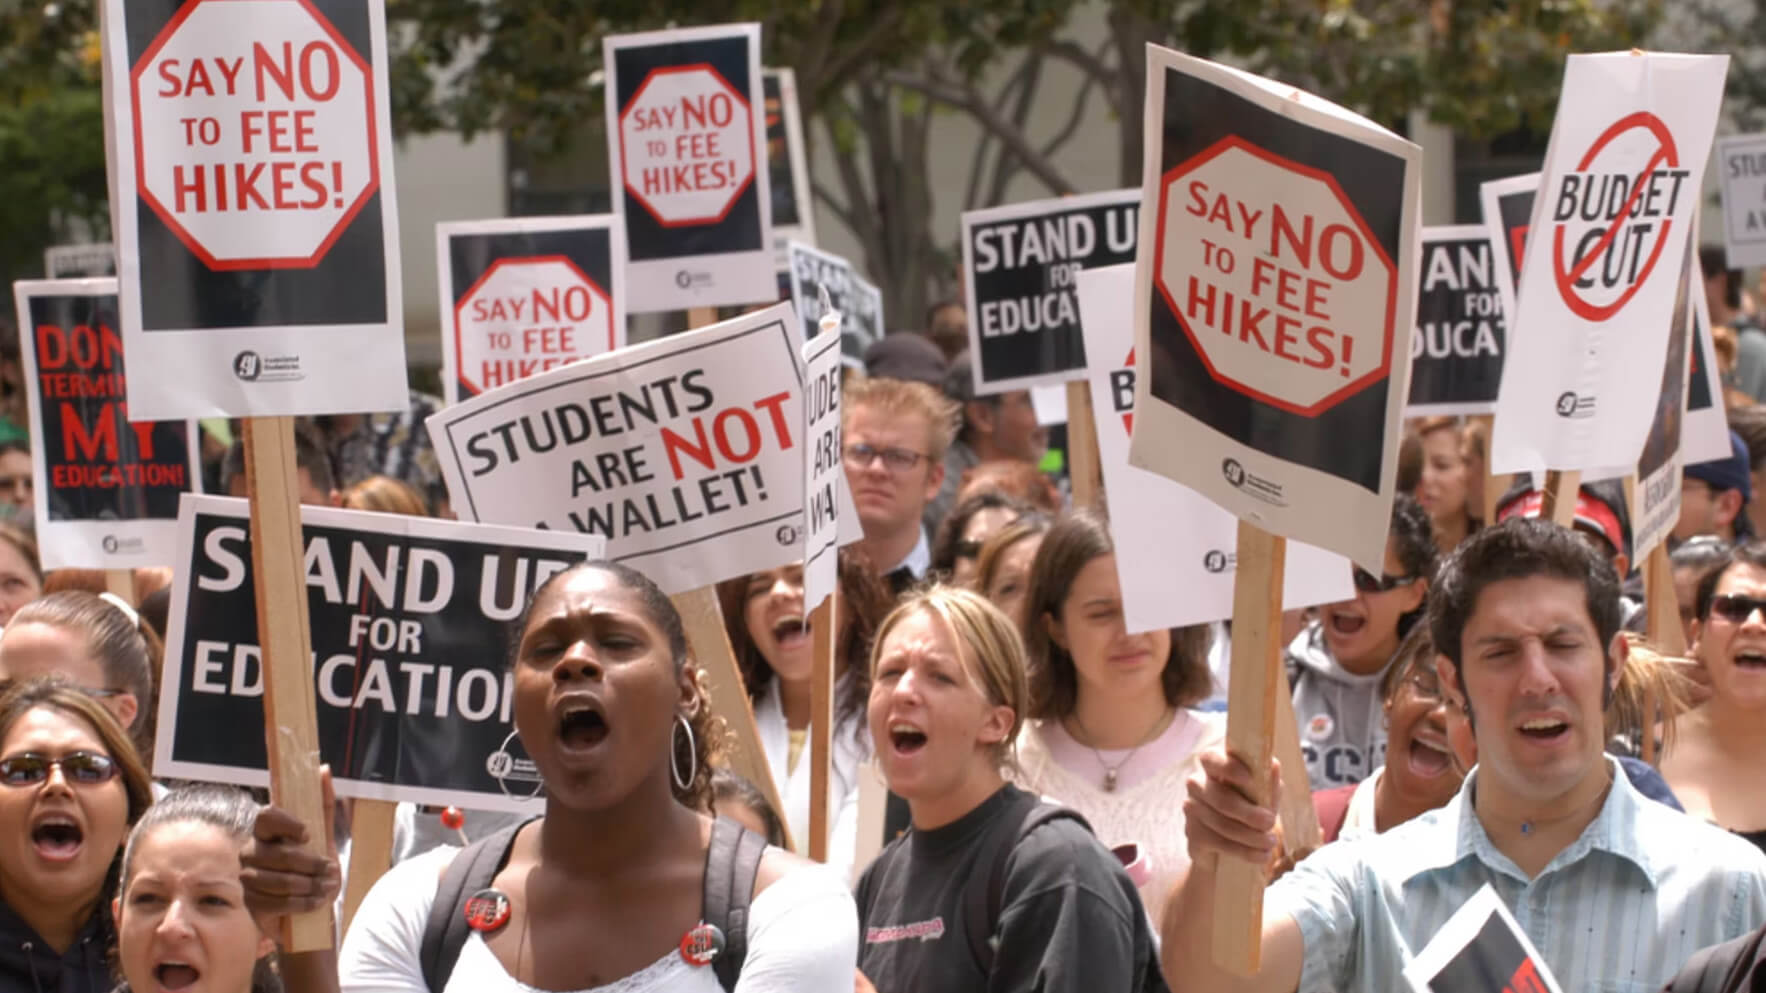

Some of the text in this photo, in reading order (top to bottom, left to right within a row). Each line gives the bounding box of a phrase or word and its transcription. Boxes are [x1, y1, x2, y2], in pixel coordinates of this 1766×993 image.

[158, 40, 341, 103] SAY NO
[180, 110, 319, 154] TO FEE
[633, 106, 677, 132] SAY
[680, 91, 733, 130] NO
[647, 132, 721, 161] TO FEE
[1728, 153, 1766, 179] STU
[173, 160, 344, 213] HIKES!
[642, 159, 736, 197] HIKES!
[1552, 170, 1691, 222] BUDGET
[974, 208, 1135, 274] STAND U
[1186, 180, 1365, 282] SAY NO
[1570, 223, 1653, 289] CUT
[472, 285, 593, 324] SAY NO
[1201, 238, 1332, 321] TO FEE
[488, 327, 577, 354] TO FEE
[981, 291, 1079, 338] EDUCA
[1187, 275, 1354, 378] HIKES!
[36, 323, 125, 371] DON
[807, 366, 839, 427] UDE
[1109, 369, 1136, 413] B
[59, 401, 157, 463] MY
[466, 369, 714, 477] STUDENTS
[570, 391, 794, 499] ARE NOT
[52, 464, 185, 489] EDUCATION!
[568, 465, 769, 541] WALLET!
[810, 482, 839, 536] WA
[198, 525, 455, 614] SAND
[349, 614, 421, 654] FOR
[192, 640, 514, 723] EDCATIO
